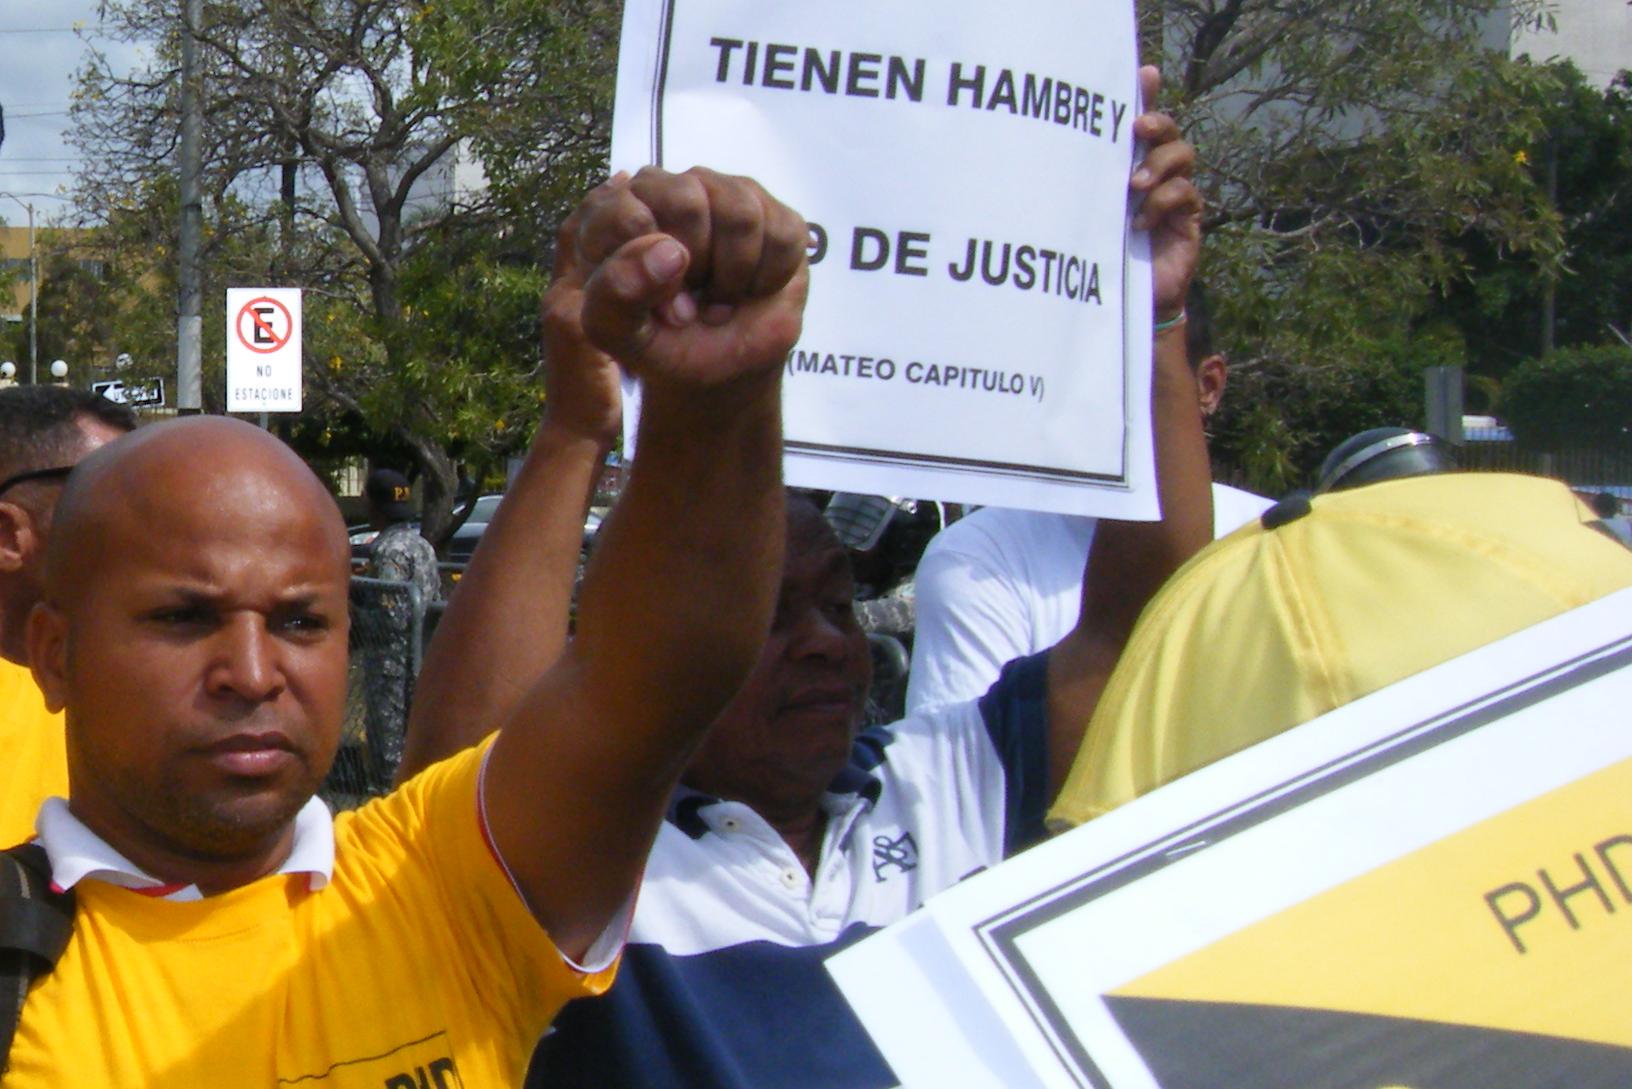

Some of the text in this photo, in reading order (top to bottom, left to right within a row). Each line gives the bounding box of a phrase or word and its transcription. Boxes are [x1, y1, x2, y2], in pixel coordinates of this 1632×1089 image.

[710, 36, 1127, 144] TIENEN HAMBRE Y
[850, 226, 931, 277] DE
[948, 237, 1103, 306] JUSTICIA
[235, 387, 293, 401] ESTACIONE
[256, 365, 273, 378] NO
[788, 349, 897, 381] (MATEO
[905, 361, 1024, 395] CAPITULO
